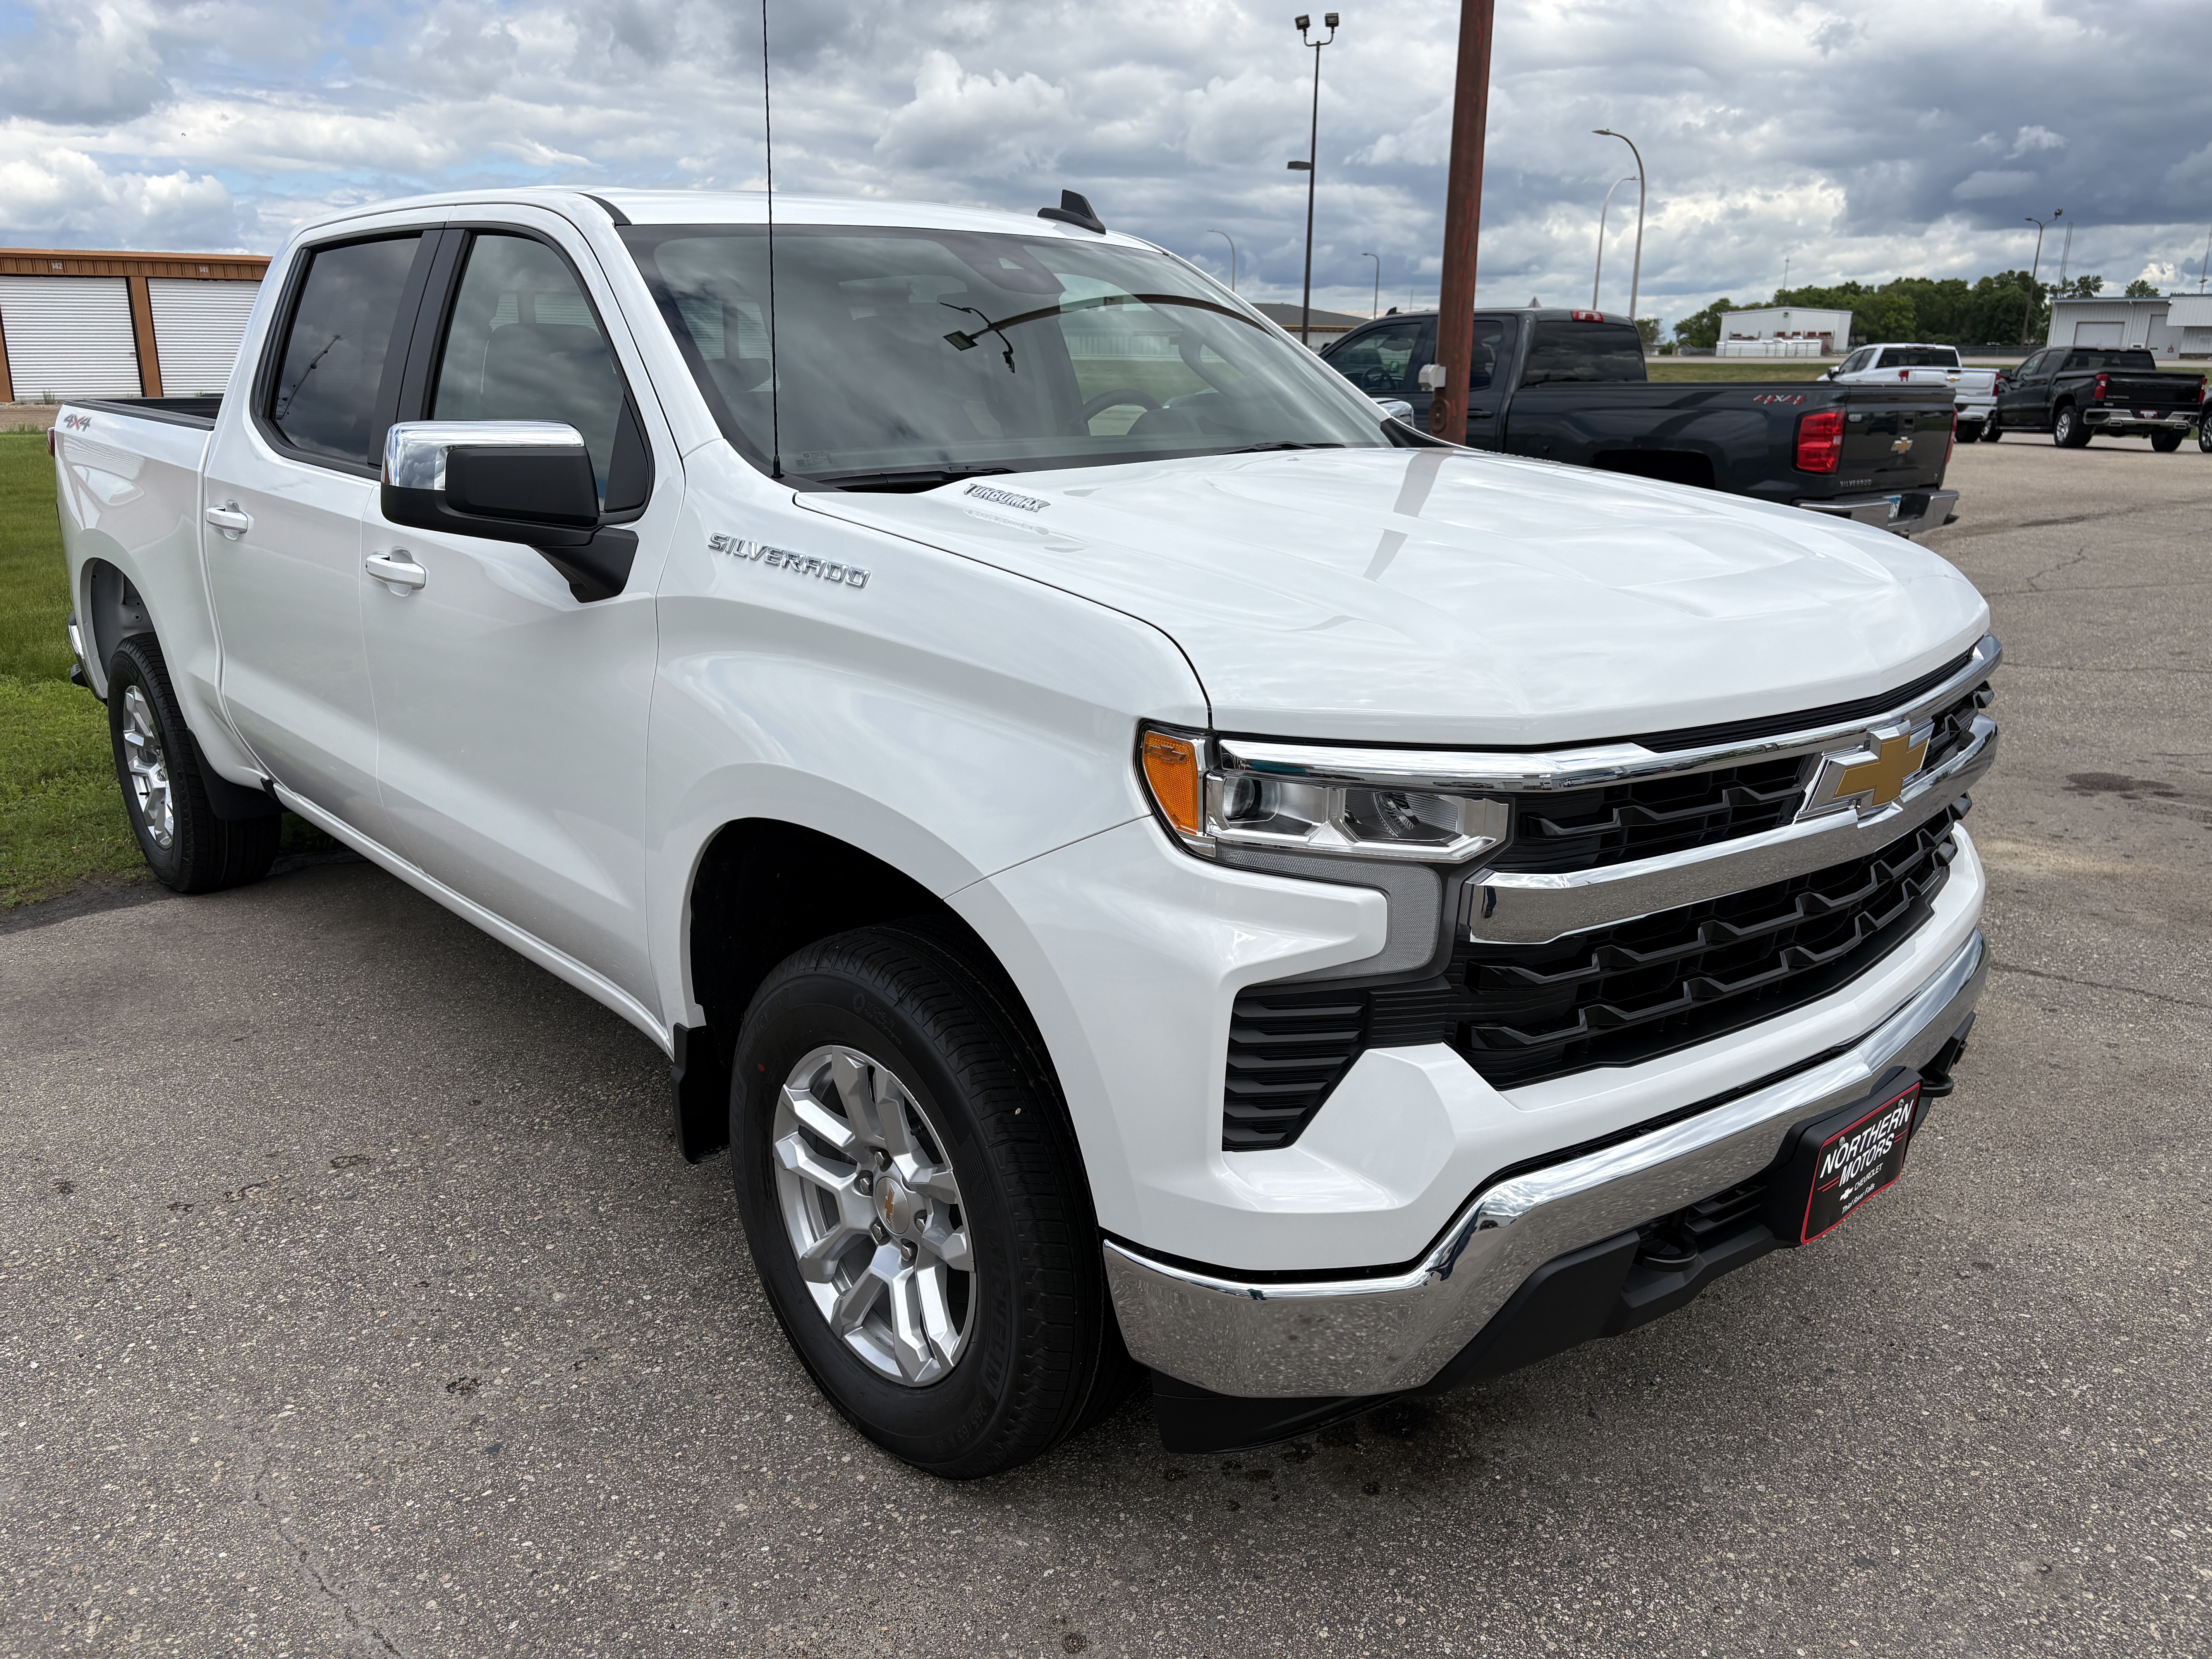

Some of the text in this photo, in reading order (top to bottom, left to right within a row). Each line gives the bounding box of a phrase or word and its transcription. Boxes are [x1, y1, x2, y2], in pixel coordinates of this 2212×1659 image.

[963, 483, 1051, 512] TURBOMAX
[708, 532, 871, 589] SILVERADO
[866, 1001, 896, 1029] MICHELIN
[1820, 1099, 1914, 1178] NORTHERN
[1839, 1133, 1894, 1187] MOTORS
[1854, 1163, 1884, 1191] CHEVROLET
[1842, 1183, 1875, 1214] Thief River Falls
